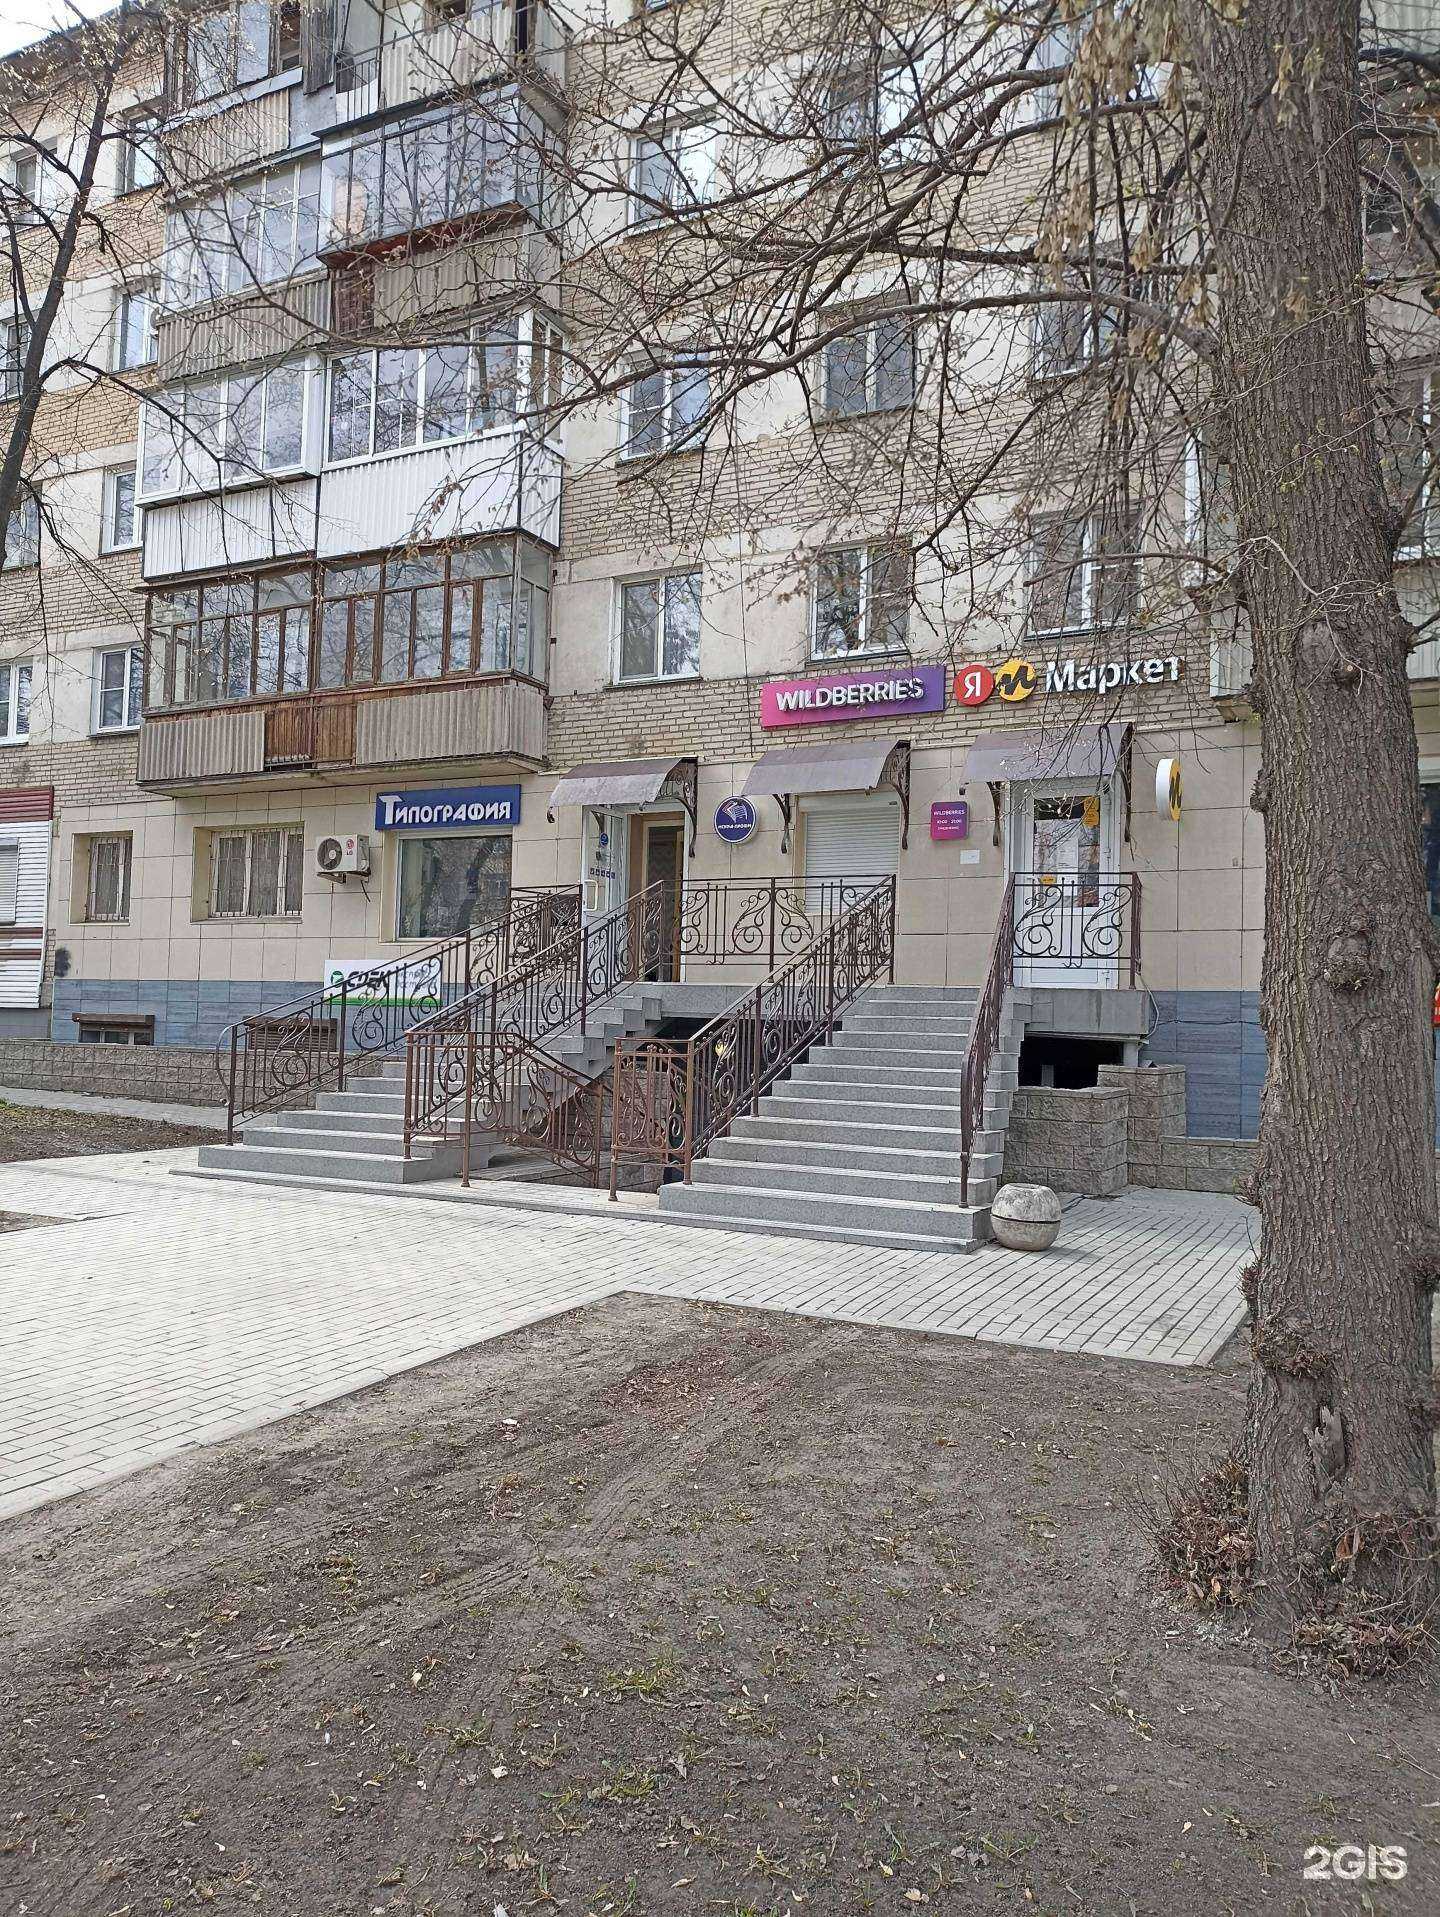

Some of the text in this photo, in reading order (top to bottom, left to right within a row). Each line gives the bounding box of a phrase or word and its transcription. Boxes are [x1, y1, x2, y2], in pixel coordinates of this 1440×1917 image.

[775, 677, 925, 712] WILDBERRIES
[963, 671, 982, 699] Я
[1045, 655, 1182, 695] Маркет
